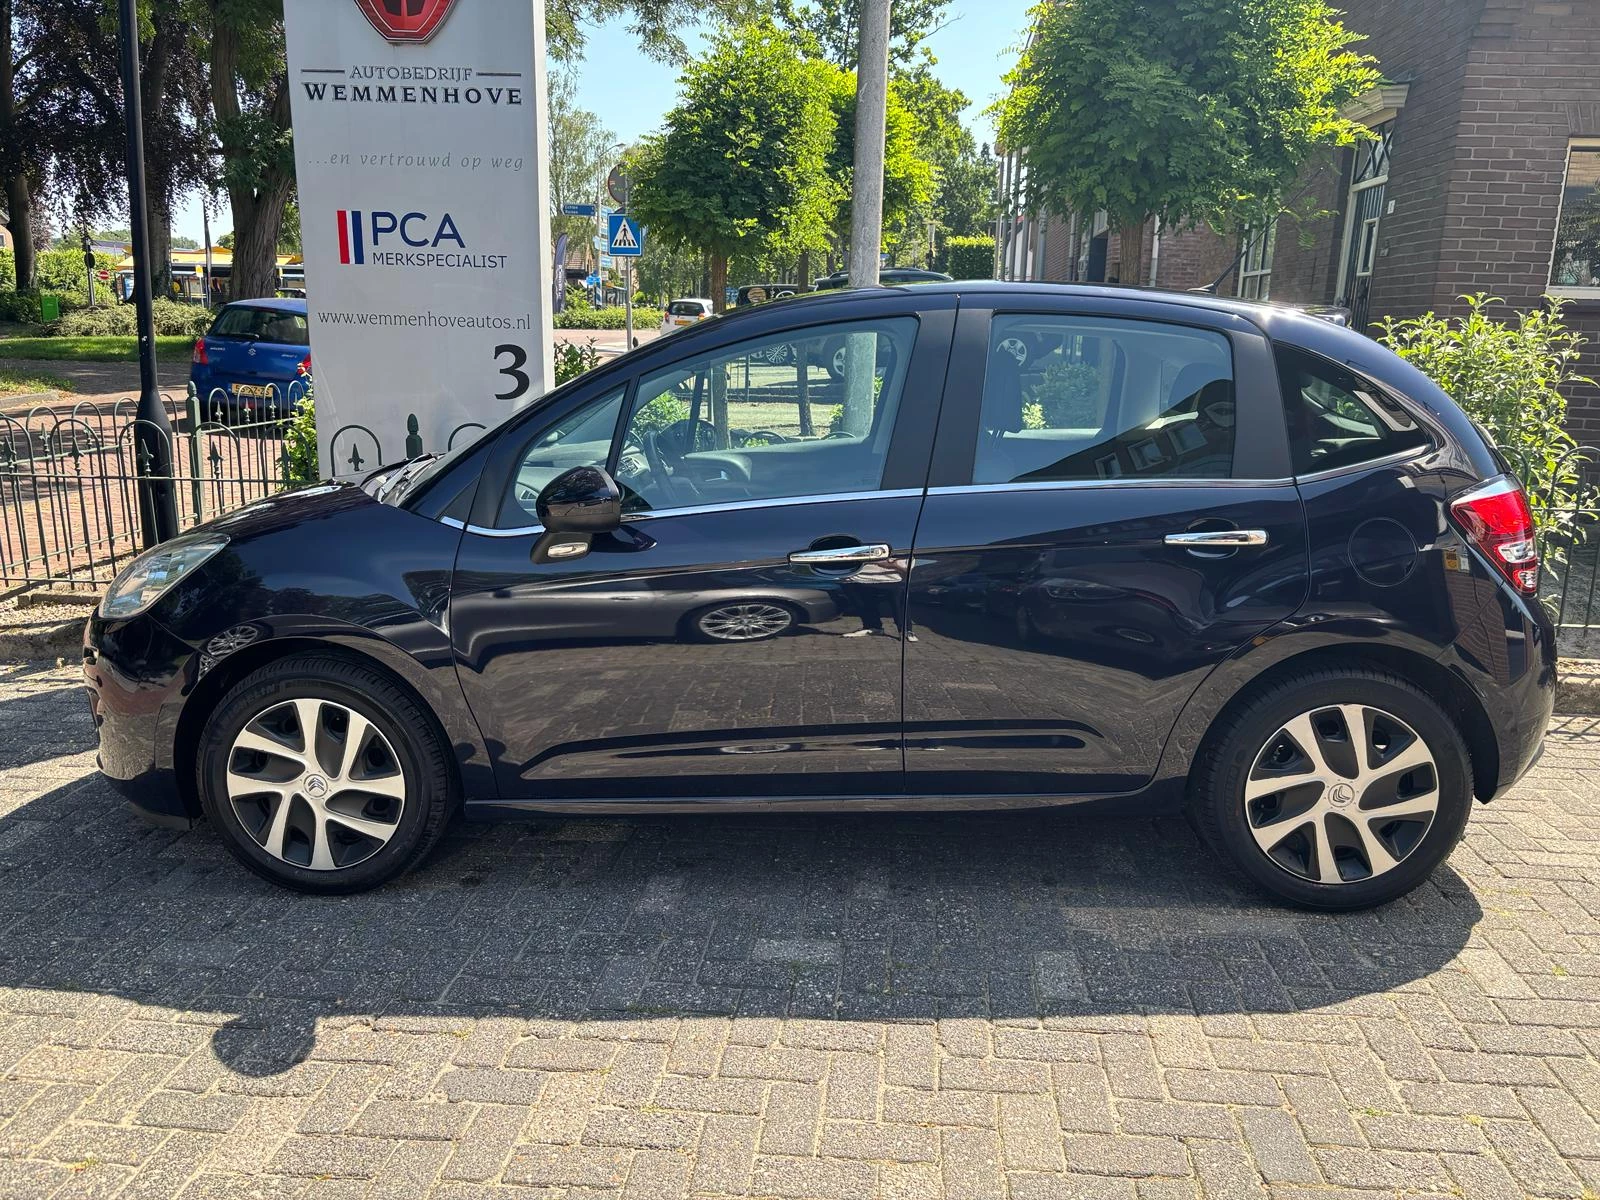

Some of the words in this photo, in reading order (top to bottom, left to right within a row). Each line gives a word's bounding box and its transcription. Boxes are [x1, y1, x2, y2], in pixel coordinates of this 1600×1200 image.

[349, 65, 473, 82] AUTOBEDRIJF
[302, 82, 522, 105] WEMMENHOVE
[360, 152, 451, 168] vertrouwd
[460, 156, 482, 170] op
[491, 157, 524, 172] weg
[371, 211, 466, 249] PCA
[372, 252, 508, 269] MERKSPECIALIST
[317, 311, 531, 330] www.wemmenhoveautos.nl
[493, 344, 530, 400] 3
